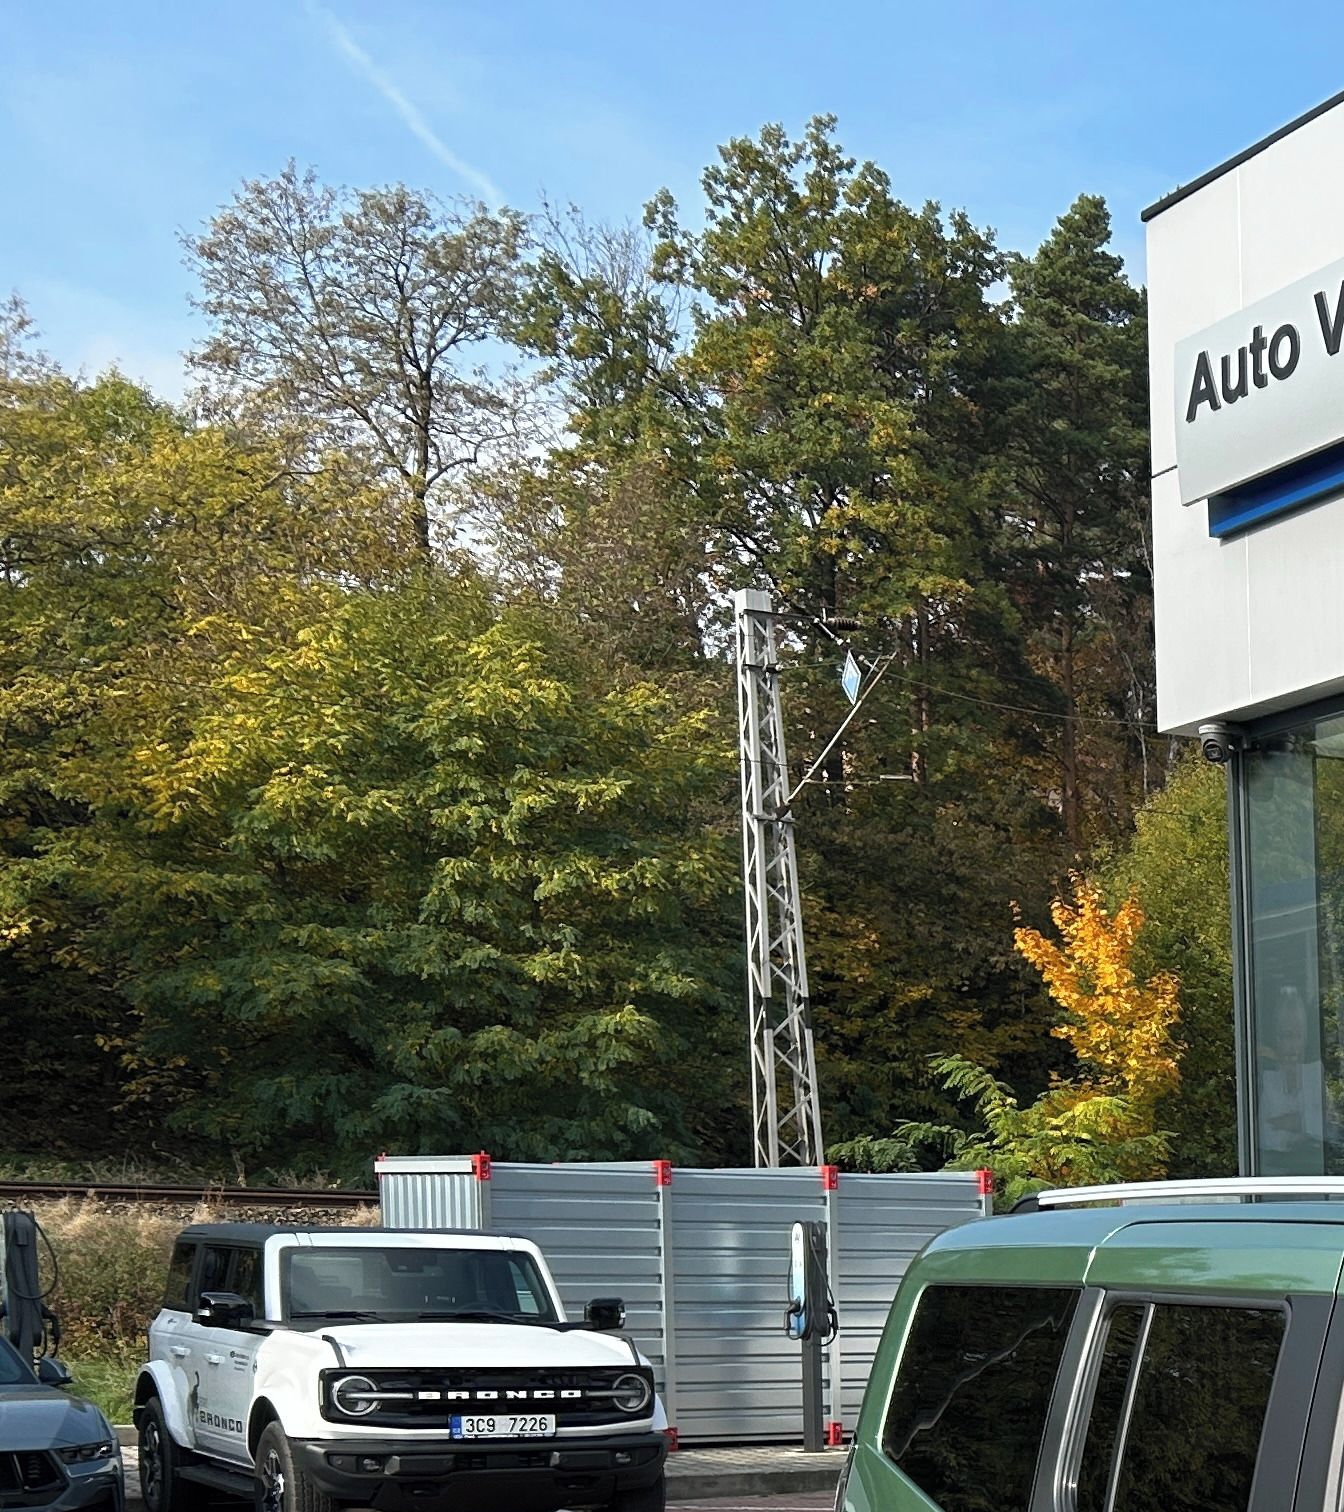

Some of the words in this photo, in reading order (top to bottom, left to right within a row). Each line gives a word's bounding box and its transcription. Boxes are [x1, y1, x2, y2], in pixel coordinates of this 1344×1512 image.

[1185, 320, 1301, 424] Auto
[418, 1389, 582, 1400] BRONCO
[465, 1418, 496, 1433] 3C9
[508, 1416, 548, 1432] 7226
